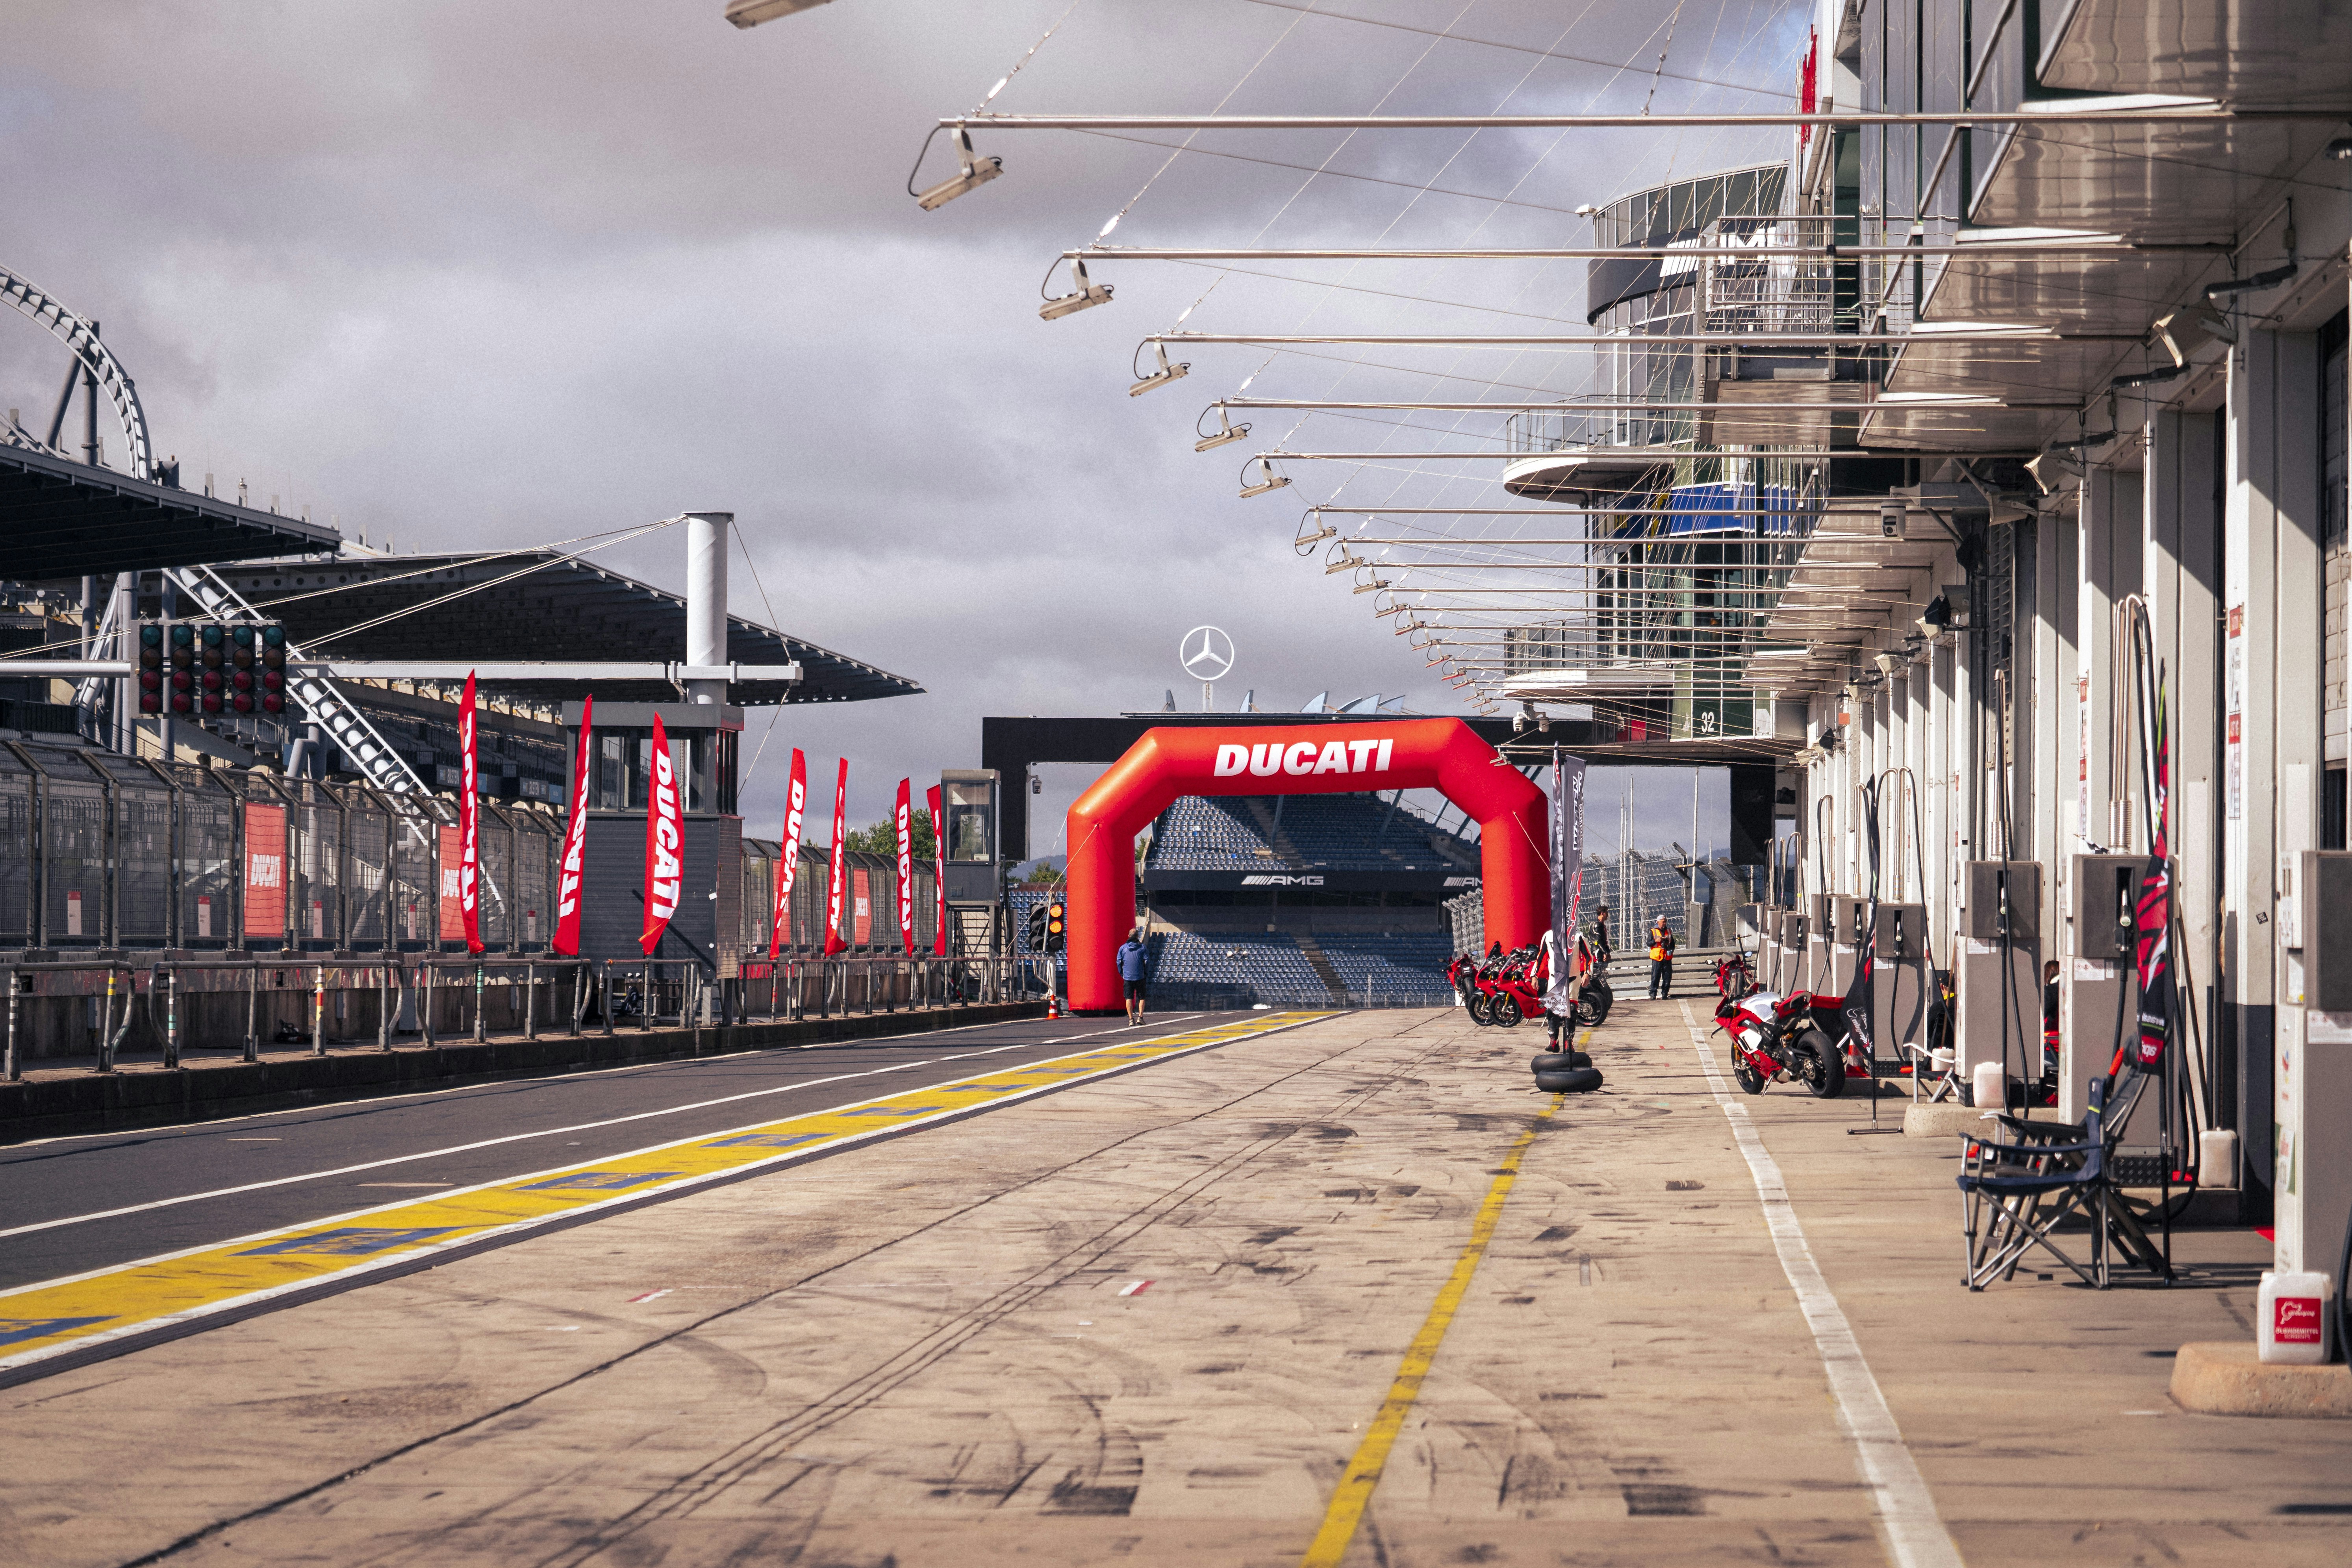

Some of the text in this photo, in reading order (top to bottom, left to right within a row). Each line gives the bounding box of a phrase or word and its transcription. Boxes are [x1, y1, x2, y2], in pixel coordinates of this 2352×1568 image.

[1701, 712, 1714, 732] 32
[1214, 739, 1393, 777] DUCATI
[652, 748, 680, 919] DUCATI
[1266, 875, 1324, 885] AMG
